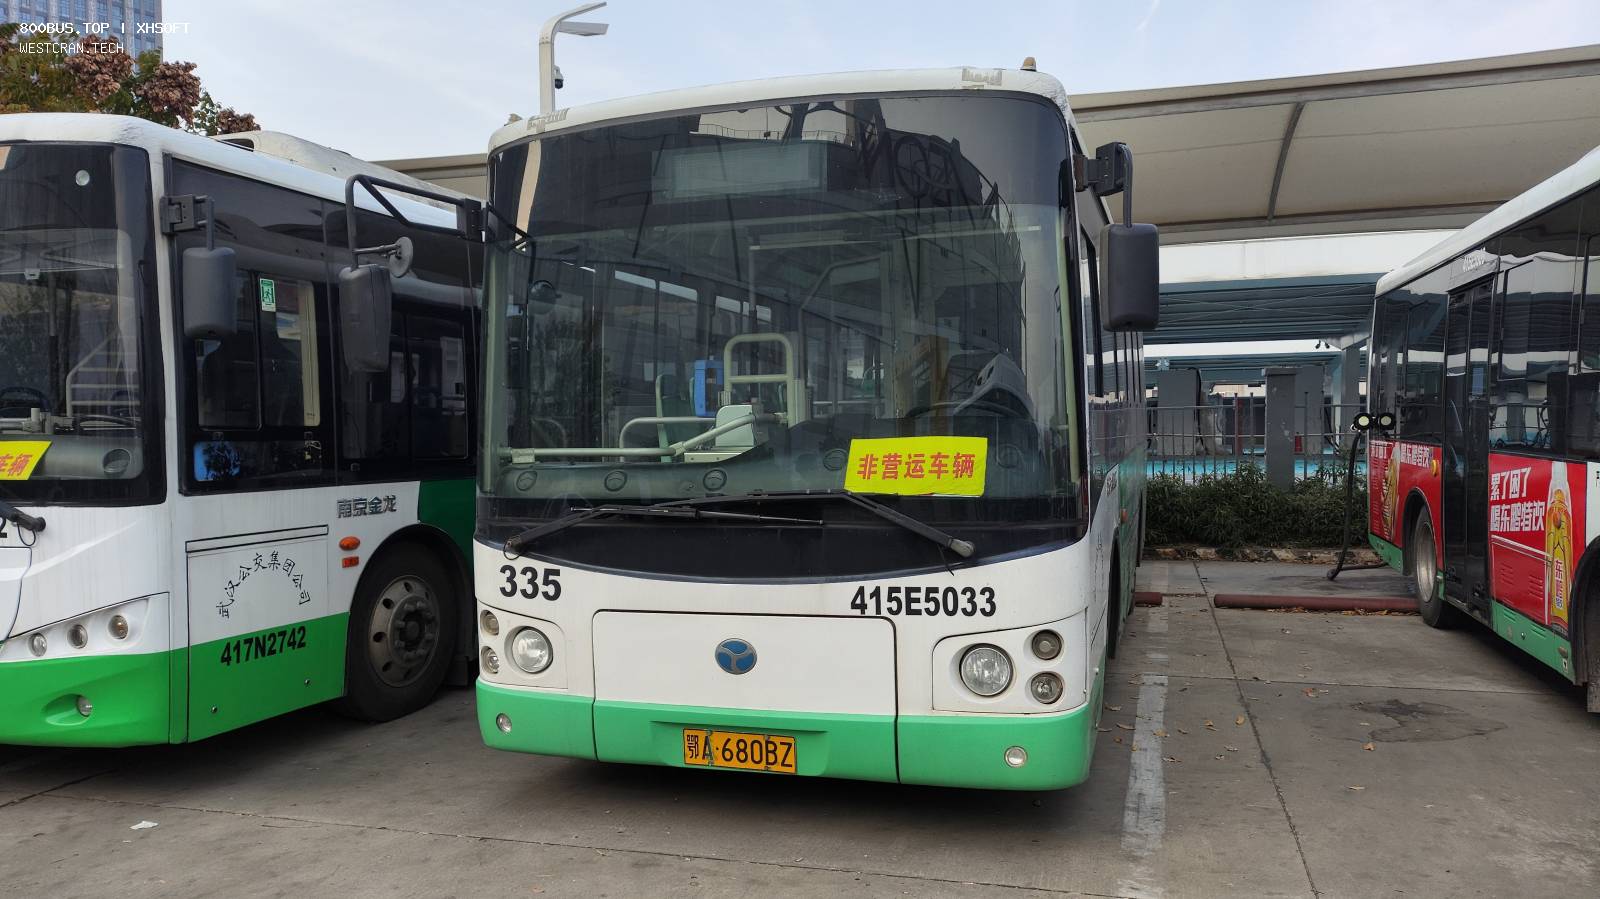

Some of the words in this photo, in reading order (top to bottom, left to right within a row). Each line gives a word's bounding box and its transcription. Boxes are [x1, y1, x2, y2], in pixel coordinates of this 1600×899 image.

[857, 452, 976, 480] 非营运车辆
[1490, 467, 1531, 501] 累了困了
[337, 494, 397, 518] 南京金龙
[1490, 500, 1545, 532] 喝东鹏特饮
[499, 564, 562, 601] 335
[850, 585, 996, 617] 415E5033
[220, 626, 306, 666] 417N2742
